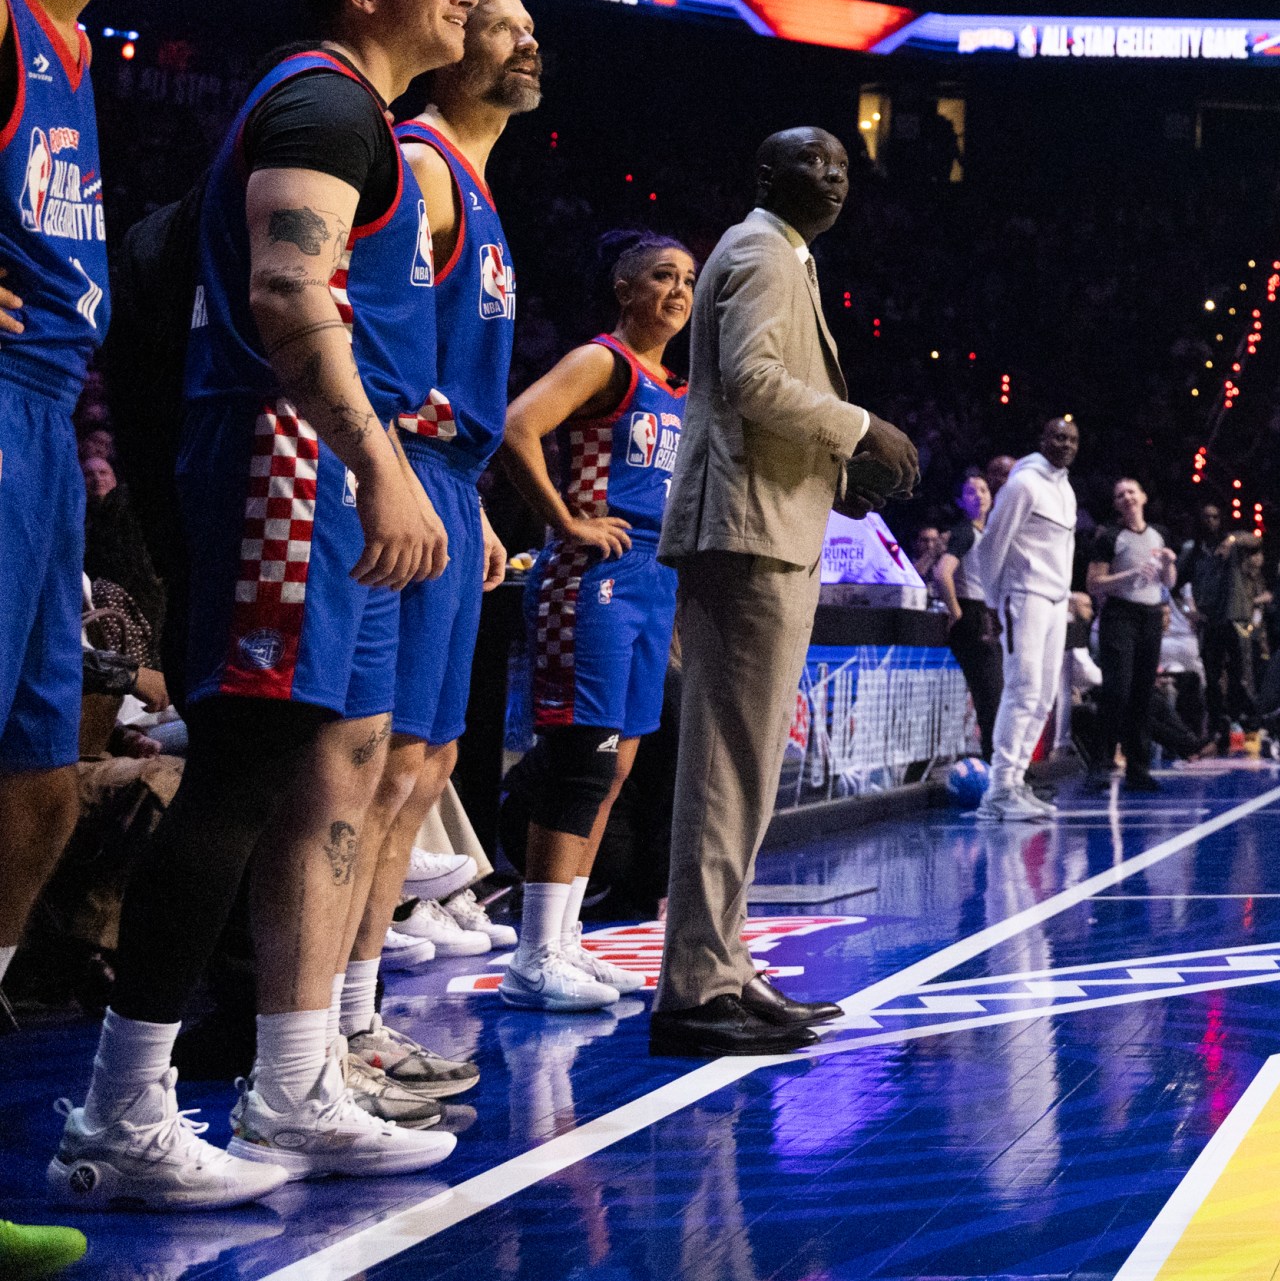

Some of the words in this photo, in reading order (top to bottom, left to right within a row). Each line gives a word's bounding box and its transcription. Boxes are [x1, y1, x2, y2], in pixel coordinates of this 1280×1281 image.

[1115, 26, 1201, 59] CELEBRITY
[1201, 27, 1249, 59] GAME
[44, 197, 93, 241] CELEBRITY
[414, 266, 429, 281] NBA
[483, 300, 501, 316] NBA
[824, 547, 864, 560] RUNCH
